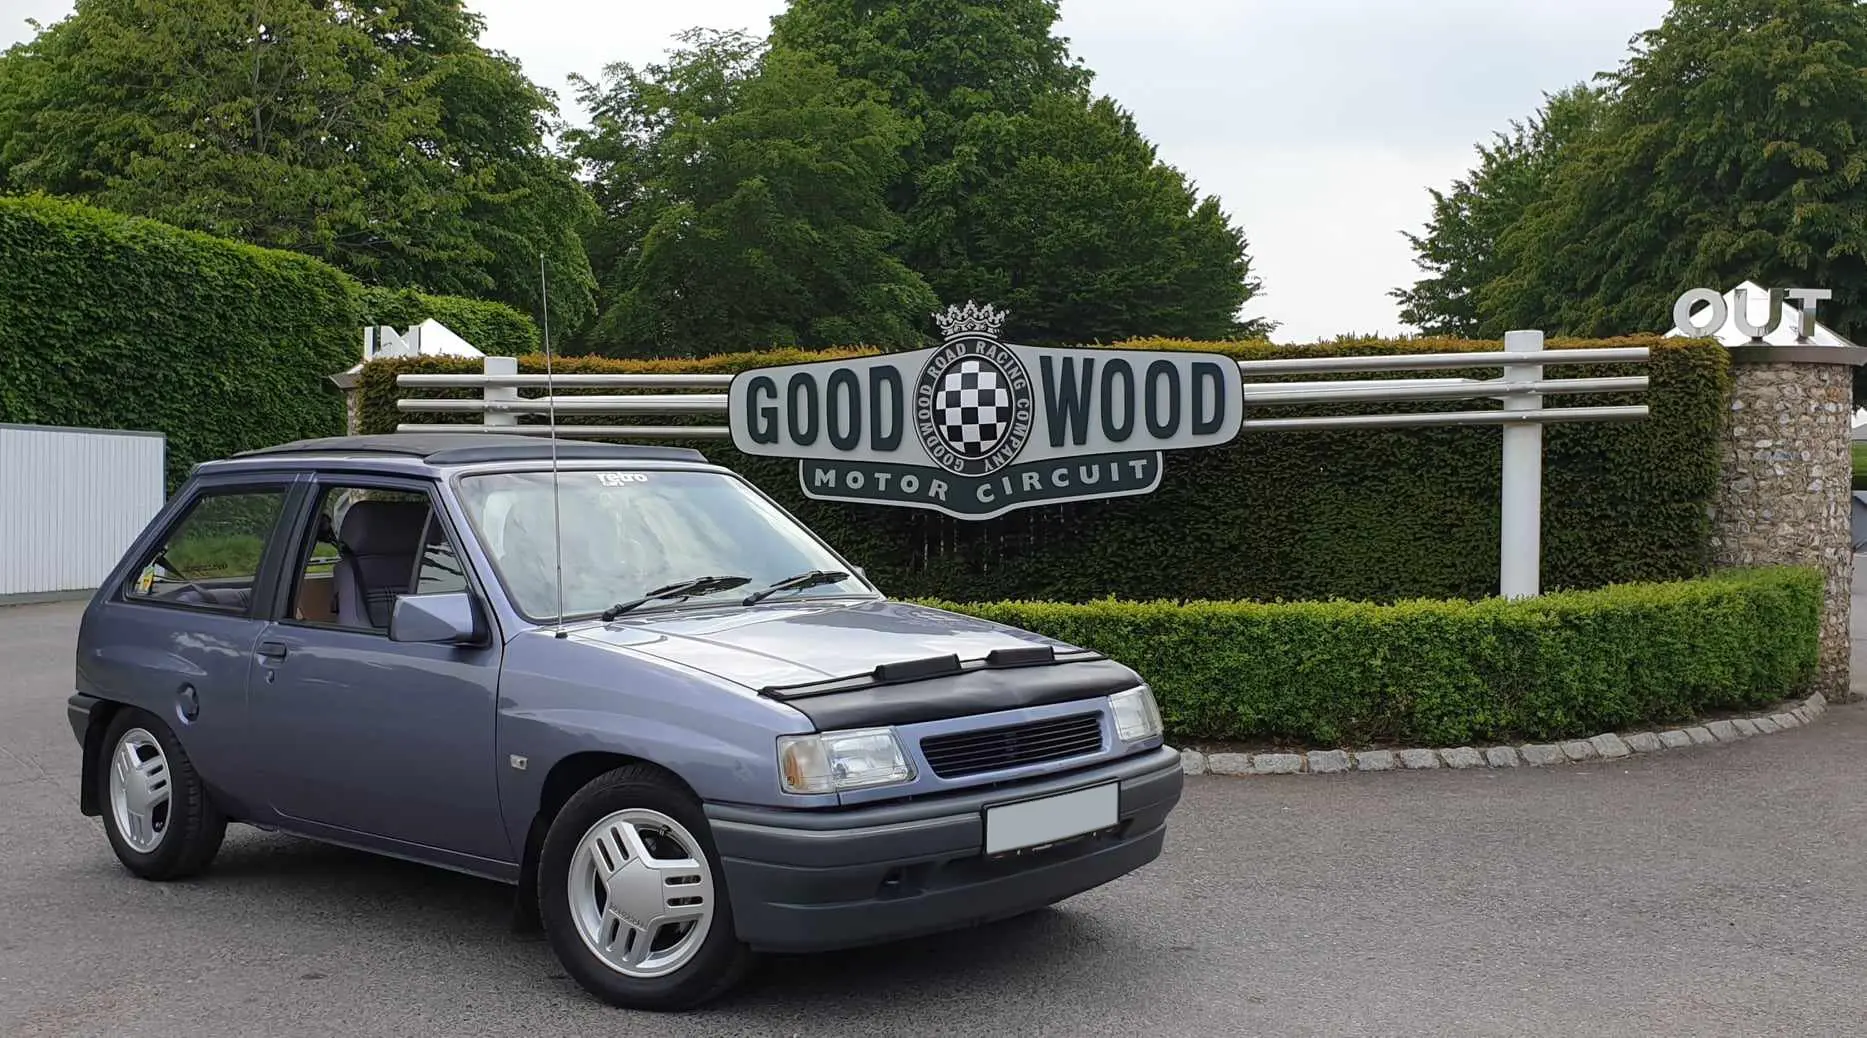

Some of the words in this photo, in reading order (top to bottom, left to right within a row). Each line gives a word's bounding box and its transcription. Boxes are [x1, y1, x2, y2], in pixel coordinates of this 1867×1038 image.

[1673, 287, 1833, 338] OUT
[364, 325, 421, 358] IN
[926, 342, 967, 379] ROAD
[975, 340, 1026, 391] RACING
[746, 364, 905, 452] GOOD
[1039, 355, 1226, 448] WOOD
[918, 384, 965, 472] GOODWOOD
[984, 398, 1030, 472] COMPANY
[814, 468, 948, 502] MOTOR
[976, 459, 1148, 503] CIRCUIT
